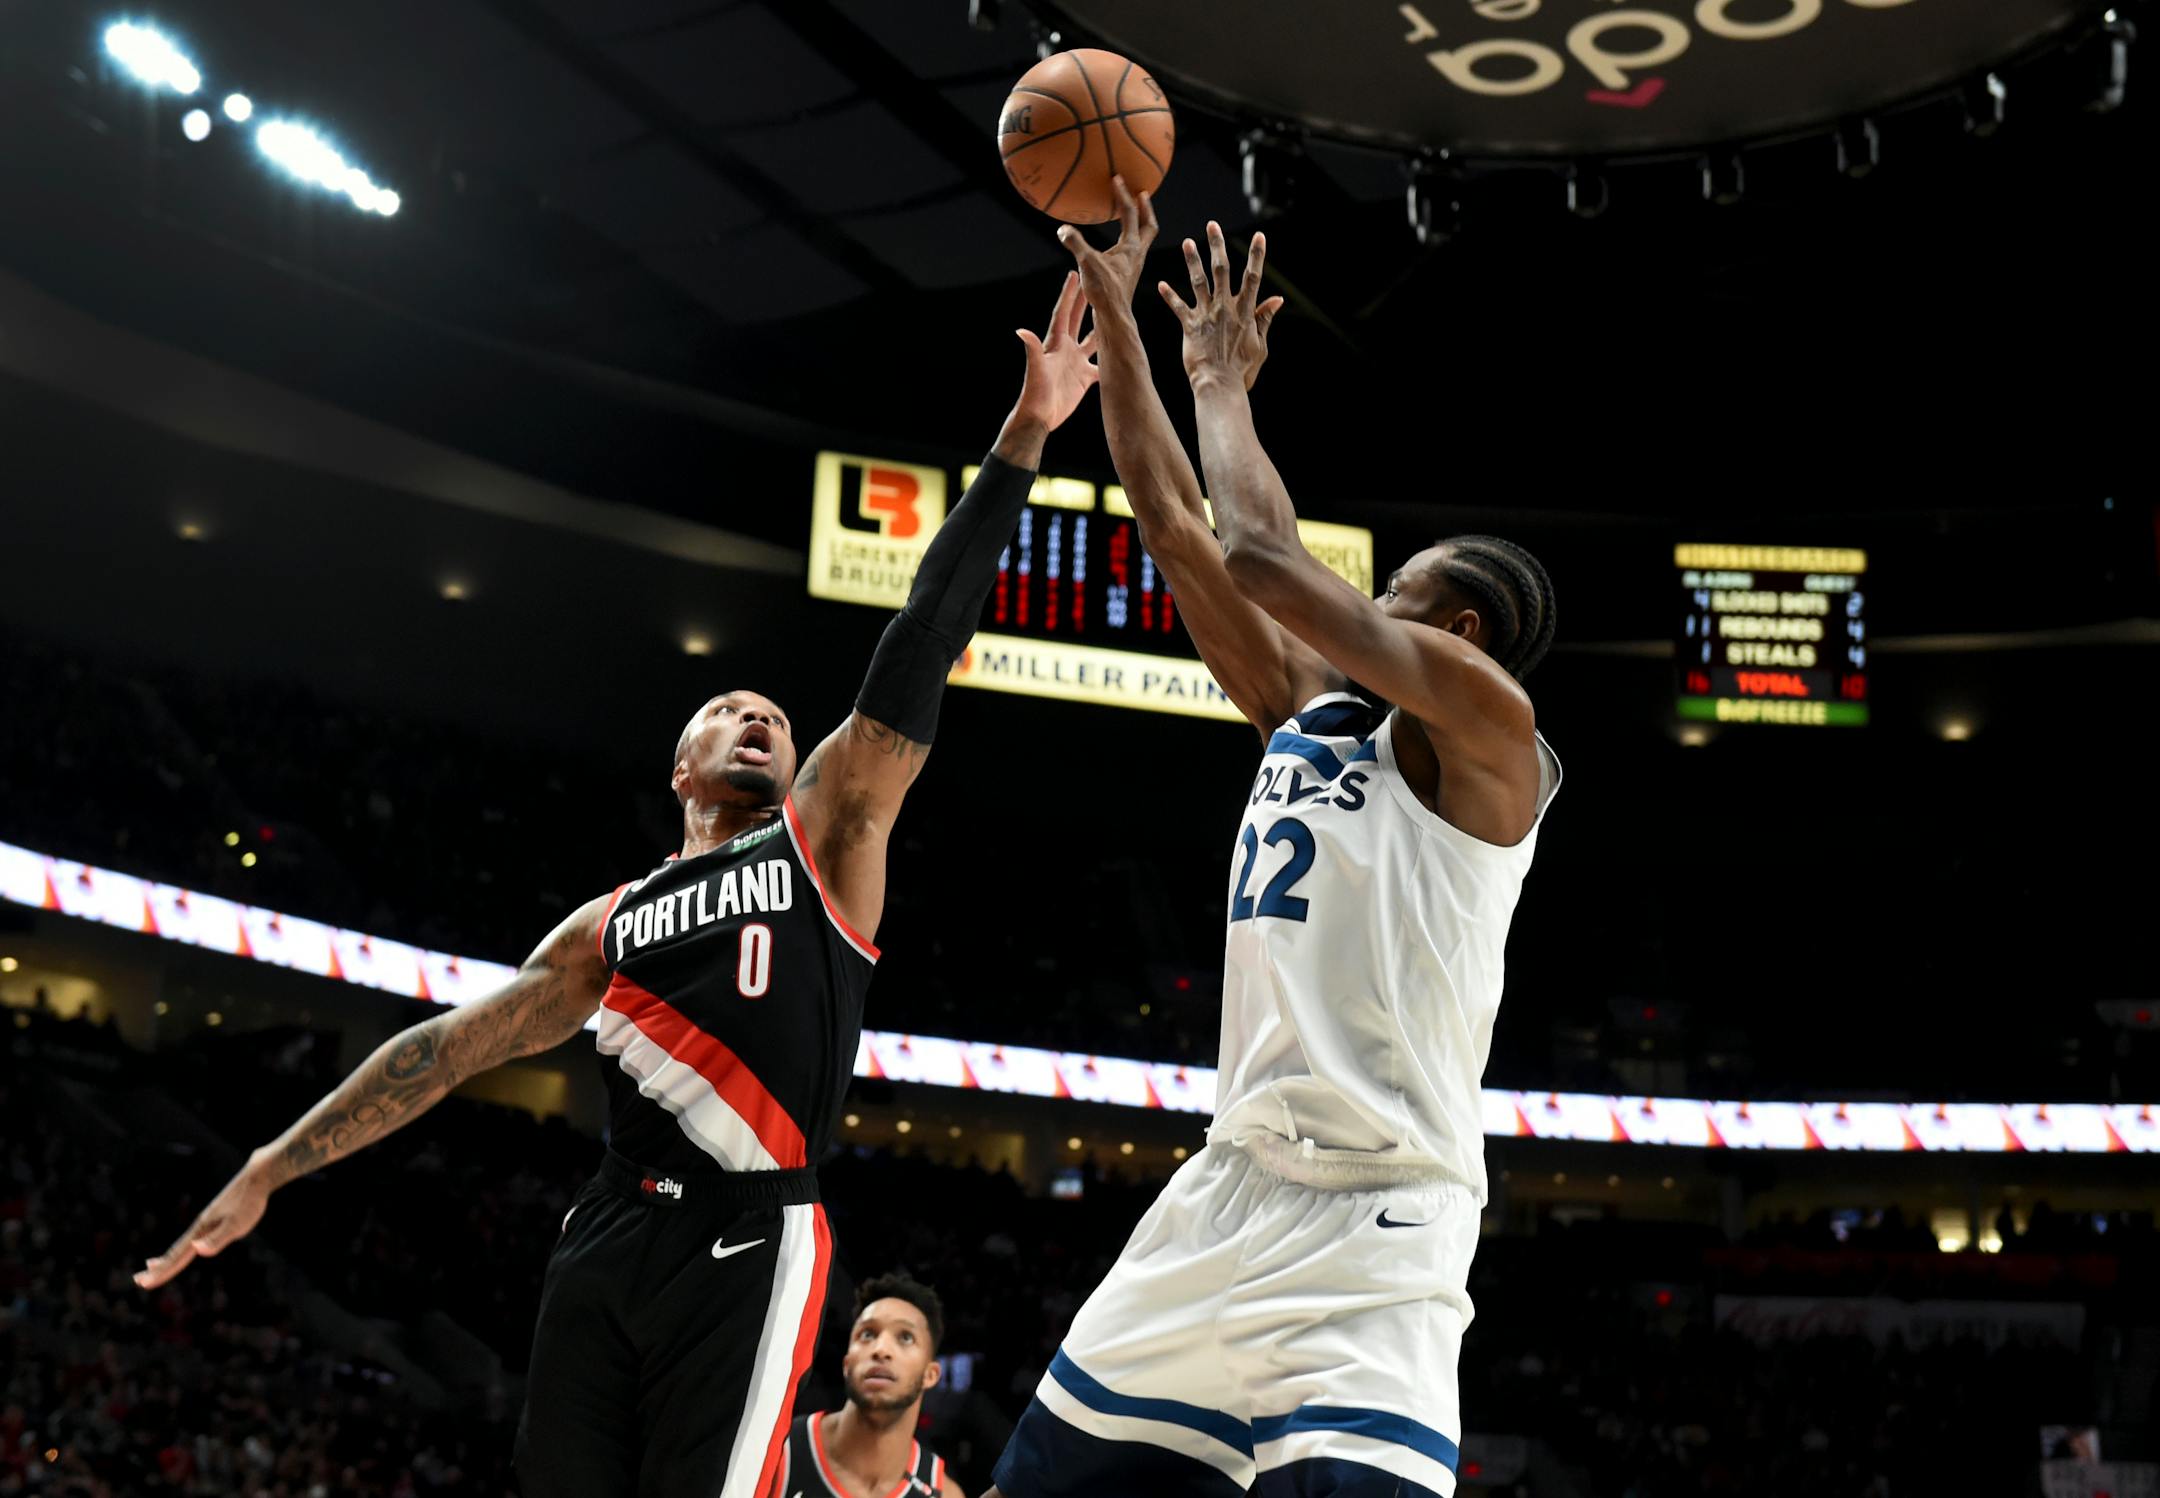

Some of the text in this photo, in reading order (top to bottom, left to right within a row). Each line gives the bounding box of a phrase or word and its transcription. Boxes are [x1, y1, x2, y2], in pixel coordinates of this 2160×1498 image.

[1719, 616, 1823, 639] REBOUNDS
[982, 651, 1124, 690] MILLER
[1726, 642, 1816, 667] STEALS
[1736, 672, 1808, 696] TOTAL
[1231, 817, 1316, 923] 22
[613, 858, 793, 962] PORTLAND
[736, 922, 772, 999] 0
